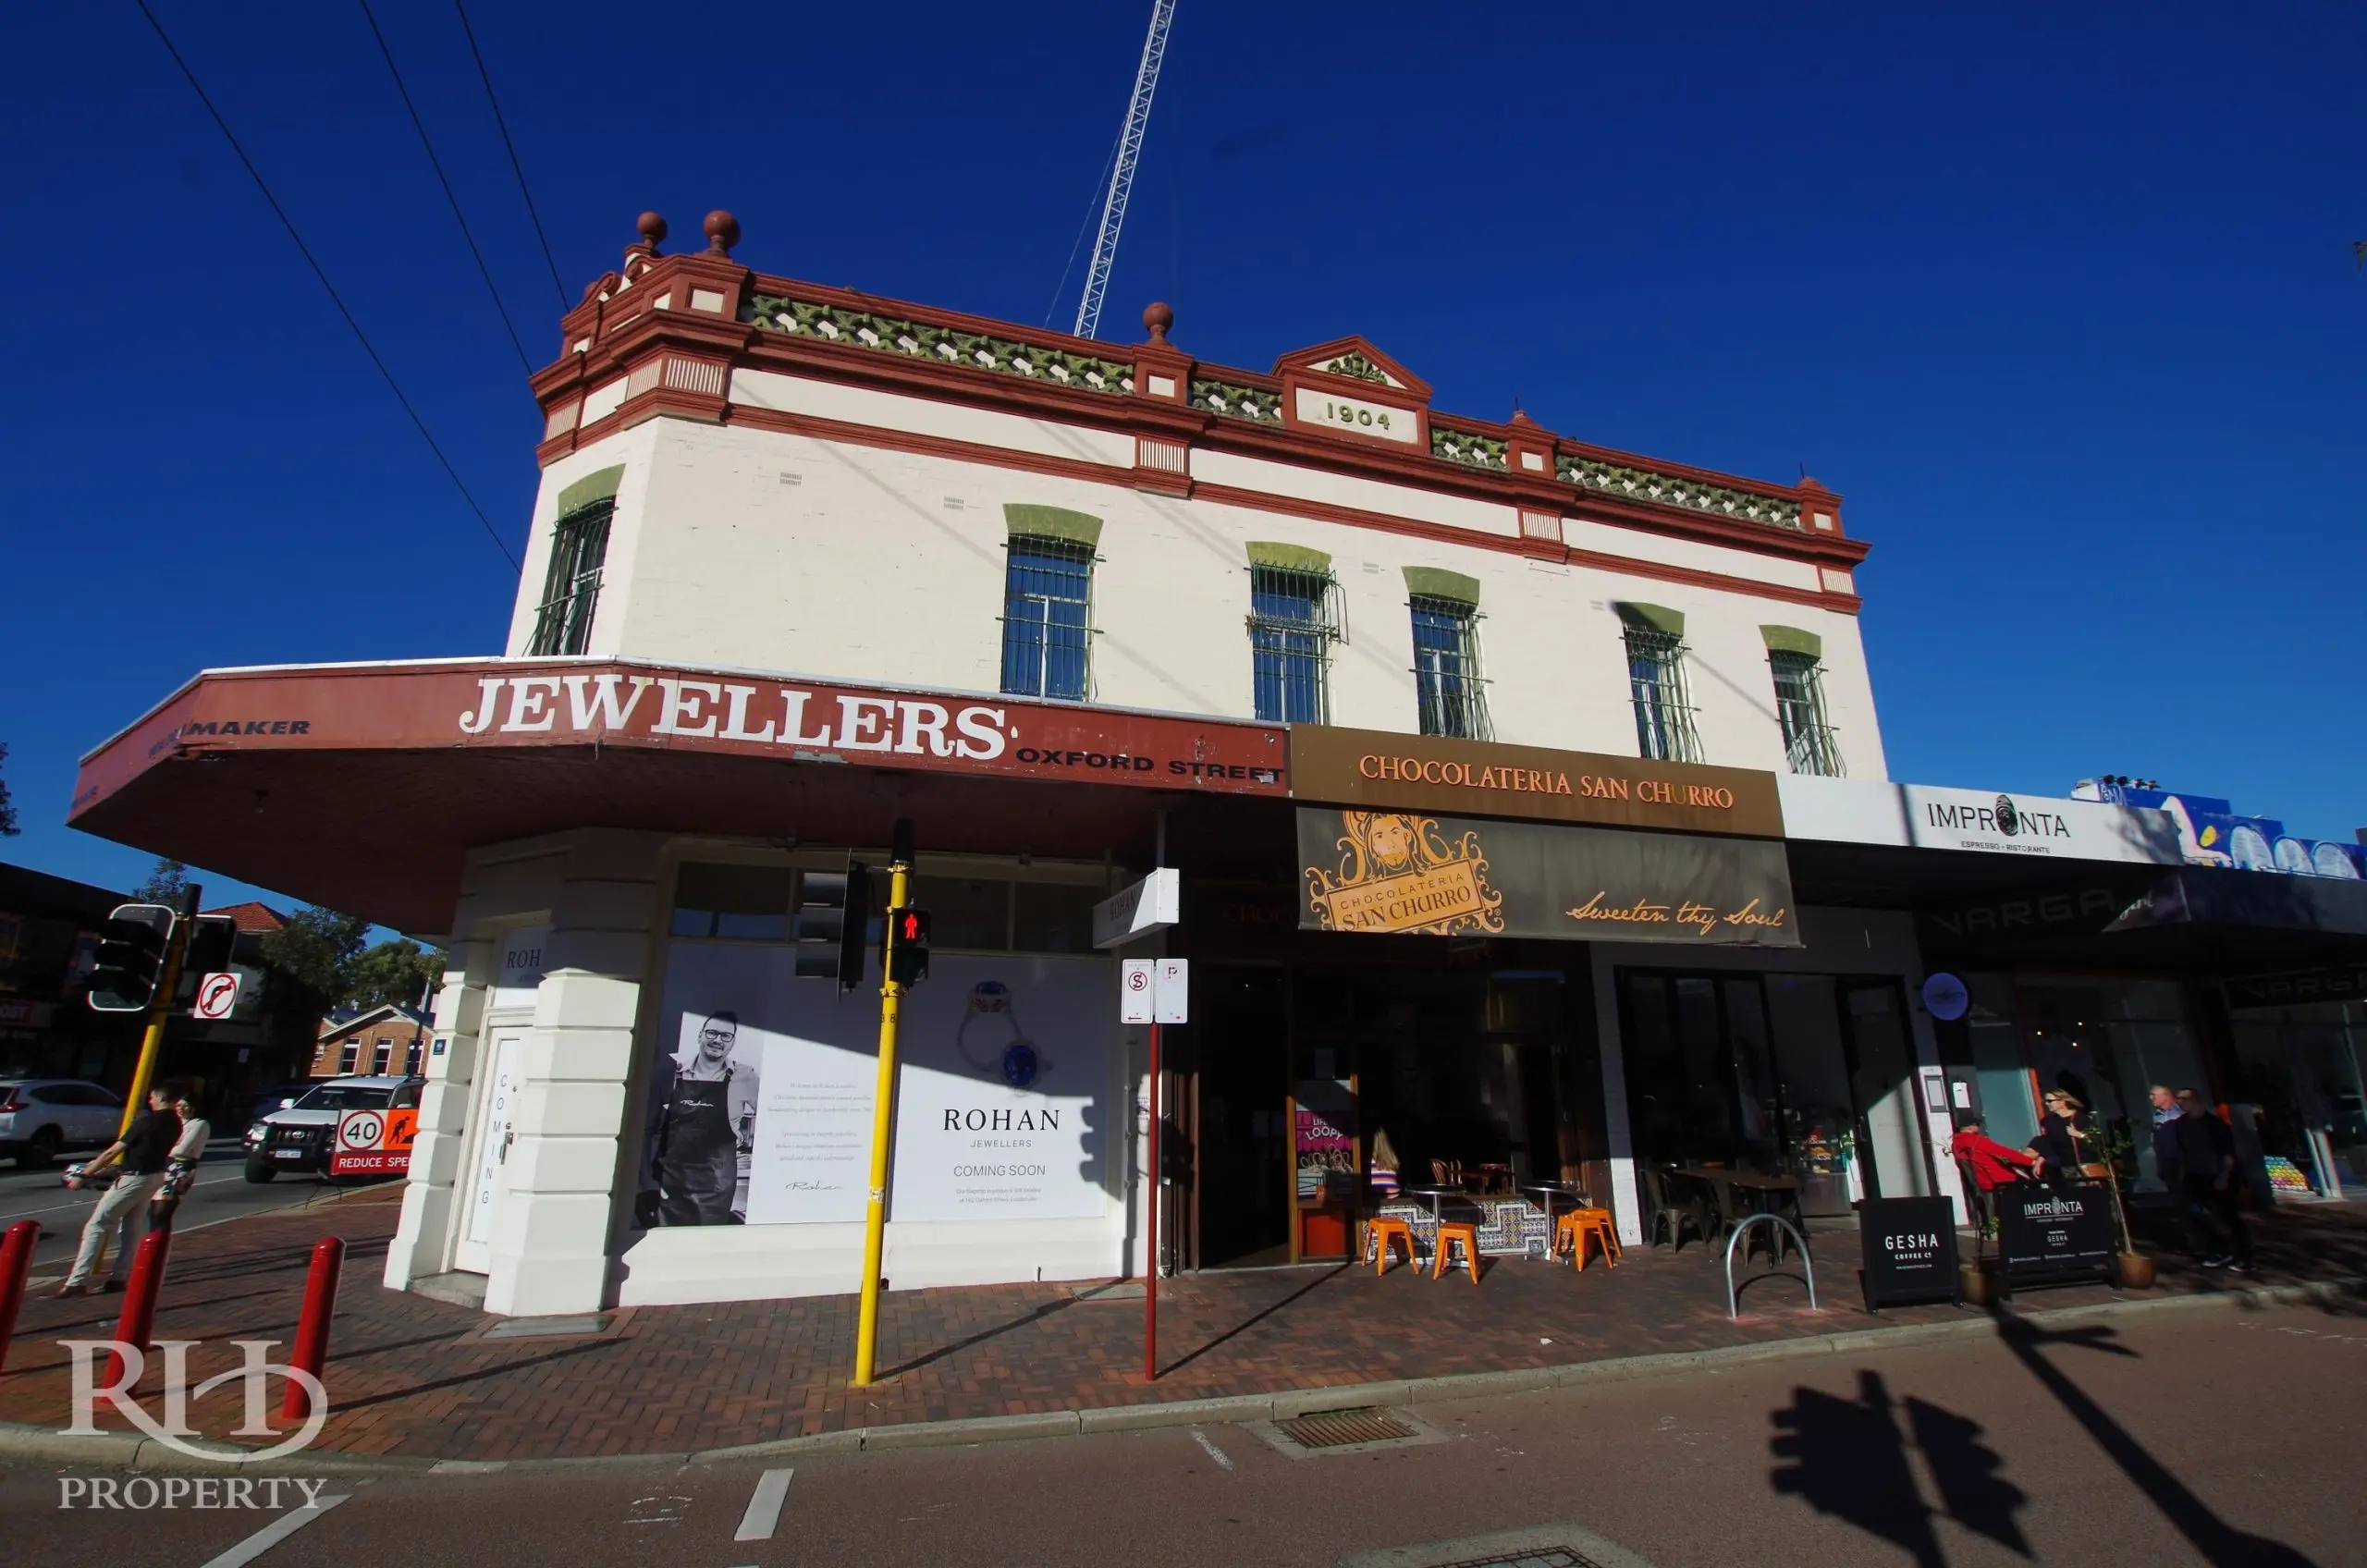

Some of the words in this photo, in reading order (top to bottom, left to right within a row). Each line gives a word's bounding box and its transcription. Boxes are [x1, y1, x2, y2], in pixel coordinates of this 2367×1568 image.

[1327, 402, 1391, 431] 1904
[459, 673, 1008, 761] JEWELLERS
[1016, 747, 1155, 772] OXFORD
[1169, 760, 1284, 783] STREET
[1359, 753, 1573, 796] CHOCOLATERIA
[1580, 775, 1629, 802] SAN
[1636, 780, 1735, 809] CHURRO
[1960, 840, 2000, 851] ESPRESSO
[2005, 843, 2051, 854] RISTORANTE
[1340, 875, 1465, 910] CHOCOLATERIA
[1342, 905, 1386, 931] SAN
[1389, 886, 1471, 920] CHURRO
[1565, 890, 1671, 921] Sweeten
[1675, 900, 1718, 937] thy
[1723, 898, 1785, 927] Soul
[1930, 888, 2116, 937] VARGA
[347, 1121, 377, 1141] 40
[943, 1109, 1061, 1132] ROHAN
[1305, 1125, 1344, 1141] LOOPY
[970, 1139, 1033, 1148] JEWELLERS
[338, 1157, 383, 1169] REDUCE
[953, 1164, 1006, 1177] COMING
[1009, 1164, 1046, 1176] SOON
[1884, 1233, 1940, 1251] GESHA
